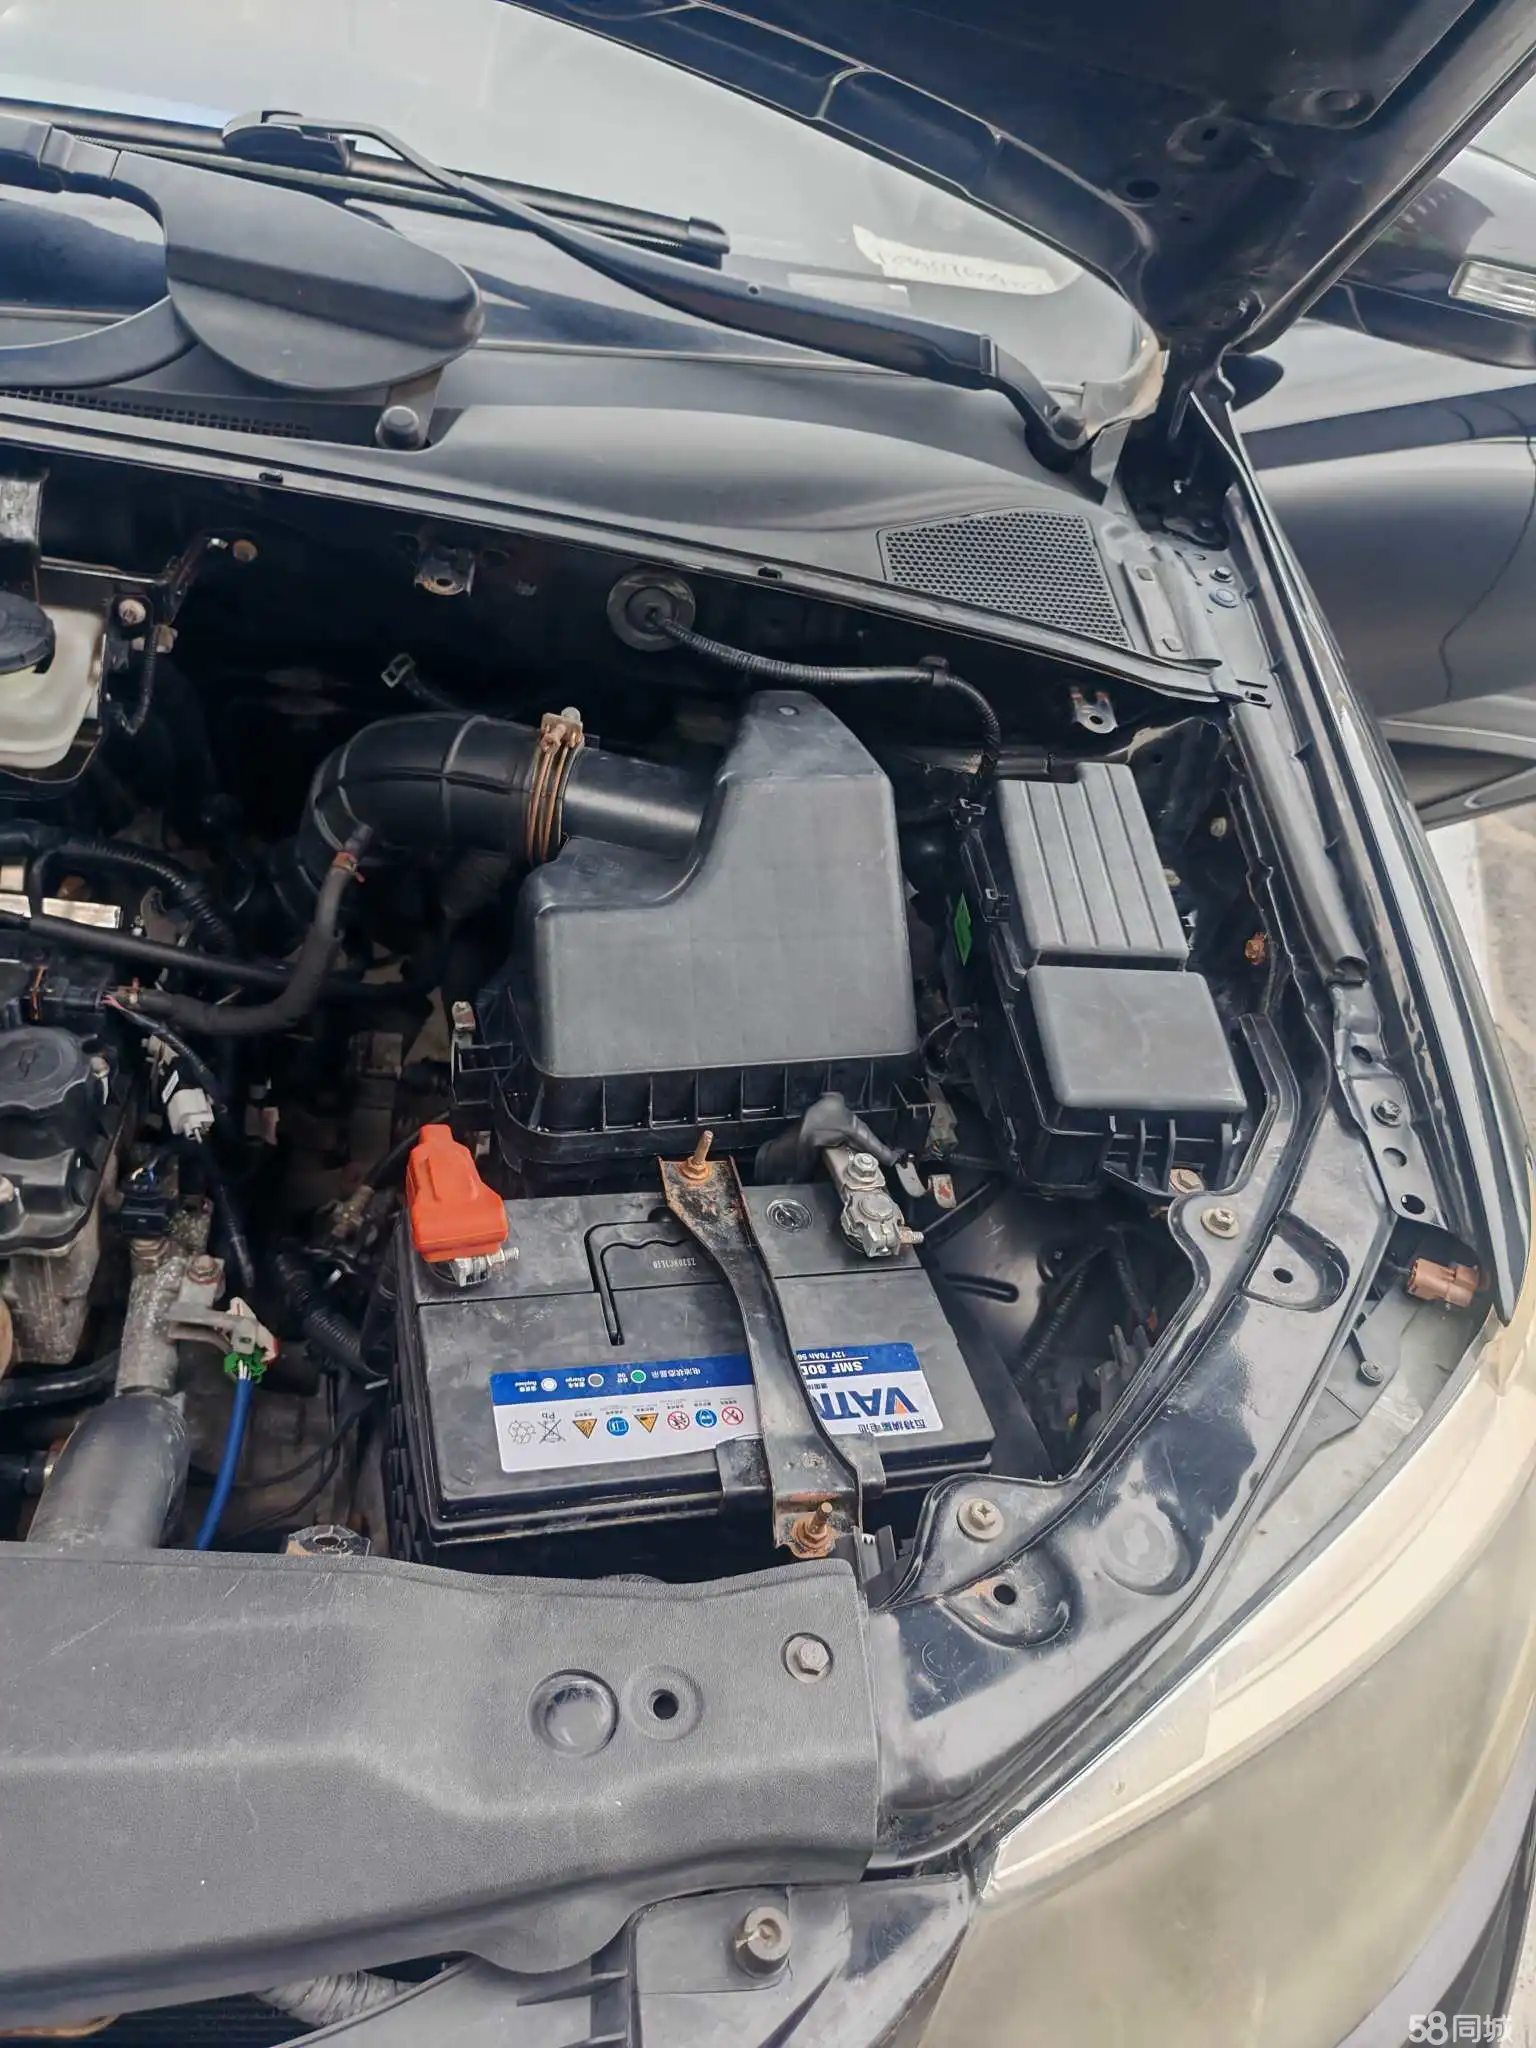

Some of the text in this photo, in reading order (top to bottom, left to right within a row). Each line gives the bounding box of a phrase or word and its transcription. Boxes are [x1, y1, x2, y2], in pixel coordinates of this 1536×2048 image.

[832, 1351, 846, 1359] 12V
[832, 1361, 863, 1374] SMF
[541, 1411, 555, 1420] Pb
